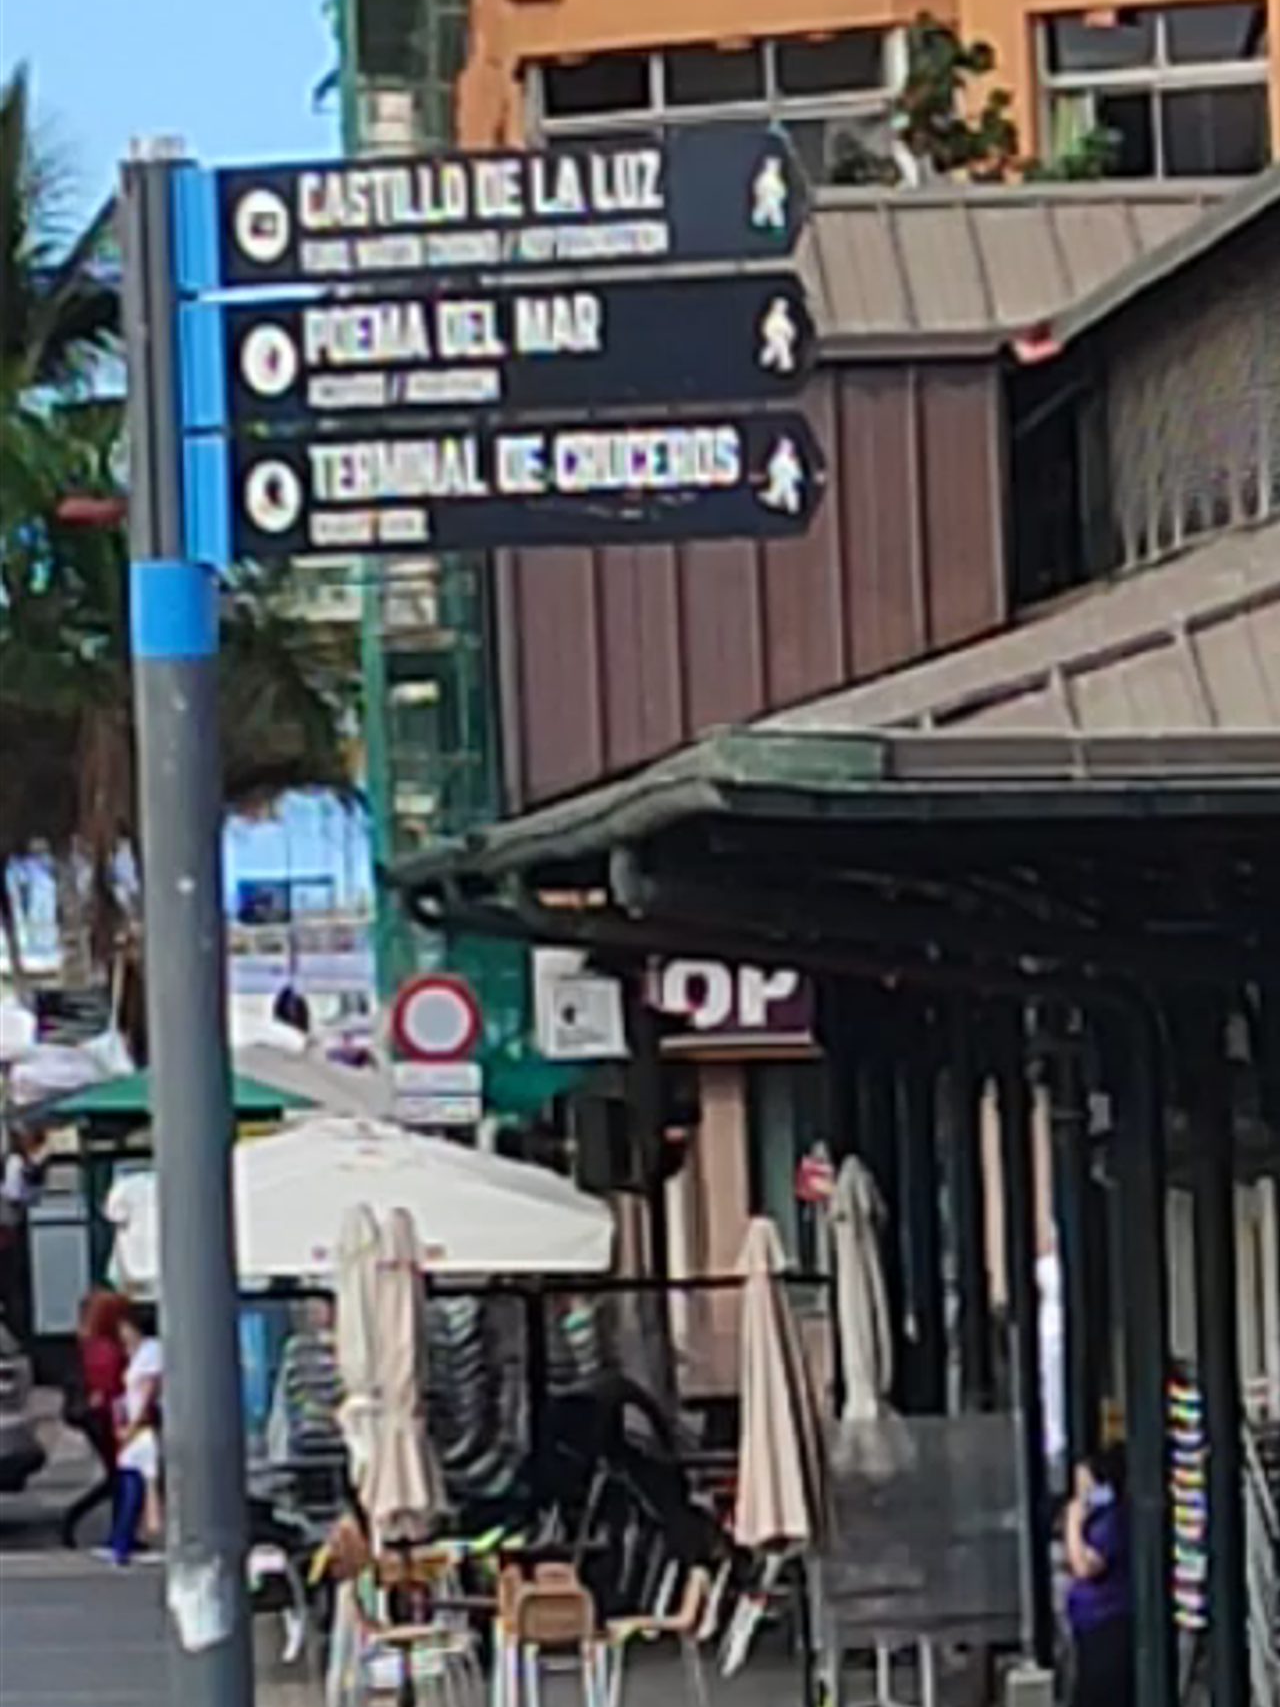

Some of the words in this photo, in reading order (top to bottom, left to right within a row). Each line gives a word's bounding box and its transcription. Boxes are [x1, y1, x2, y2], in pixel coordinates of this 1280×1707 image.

[299, 160, 467, 228] CASTILLO
[474, 157, 523, 219] DE
[530, 154, 588, 215] LA
[592, 150, 665, 212] LUZ
[305, 305, 431, 364] POEMA
[436, 300, 506, 357] DEL
[514, 292, 602, 354] MAR
[308, 435, 488, 501] TERMINAL
[496, 435, 549, 494] DE
[553, 425, 741, 490] CRUCEROS
[646, 955, 798, 1029] OP
